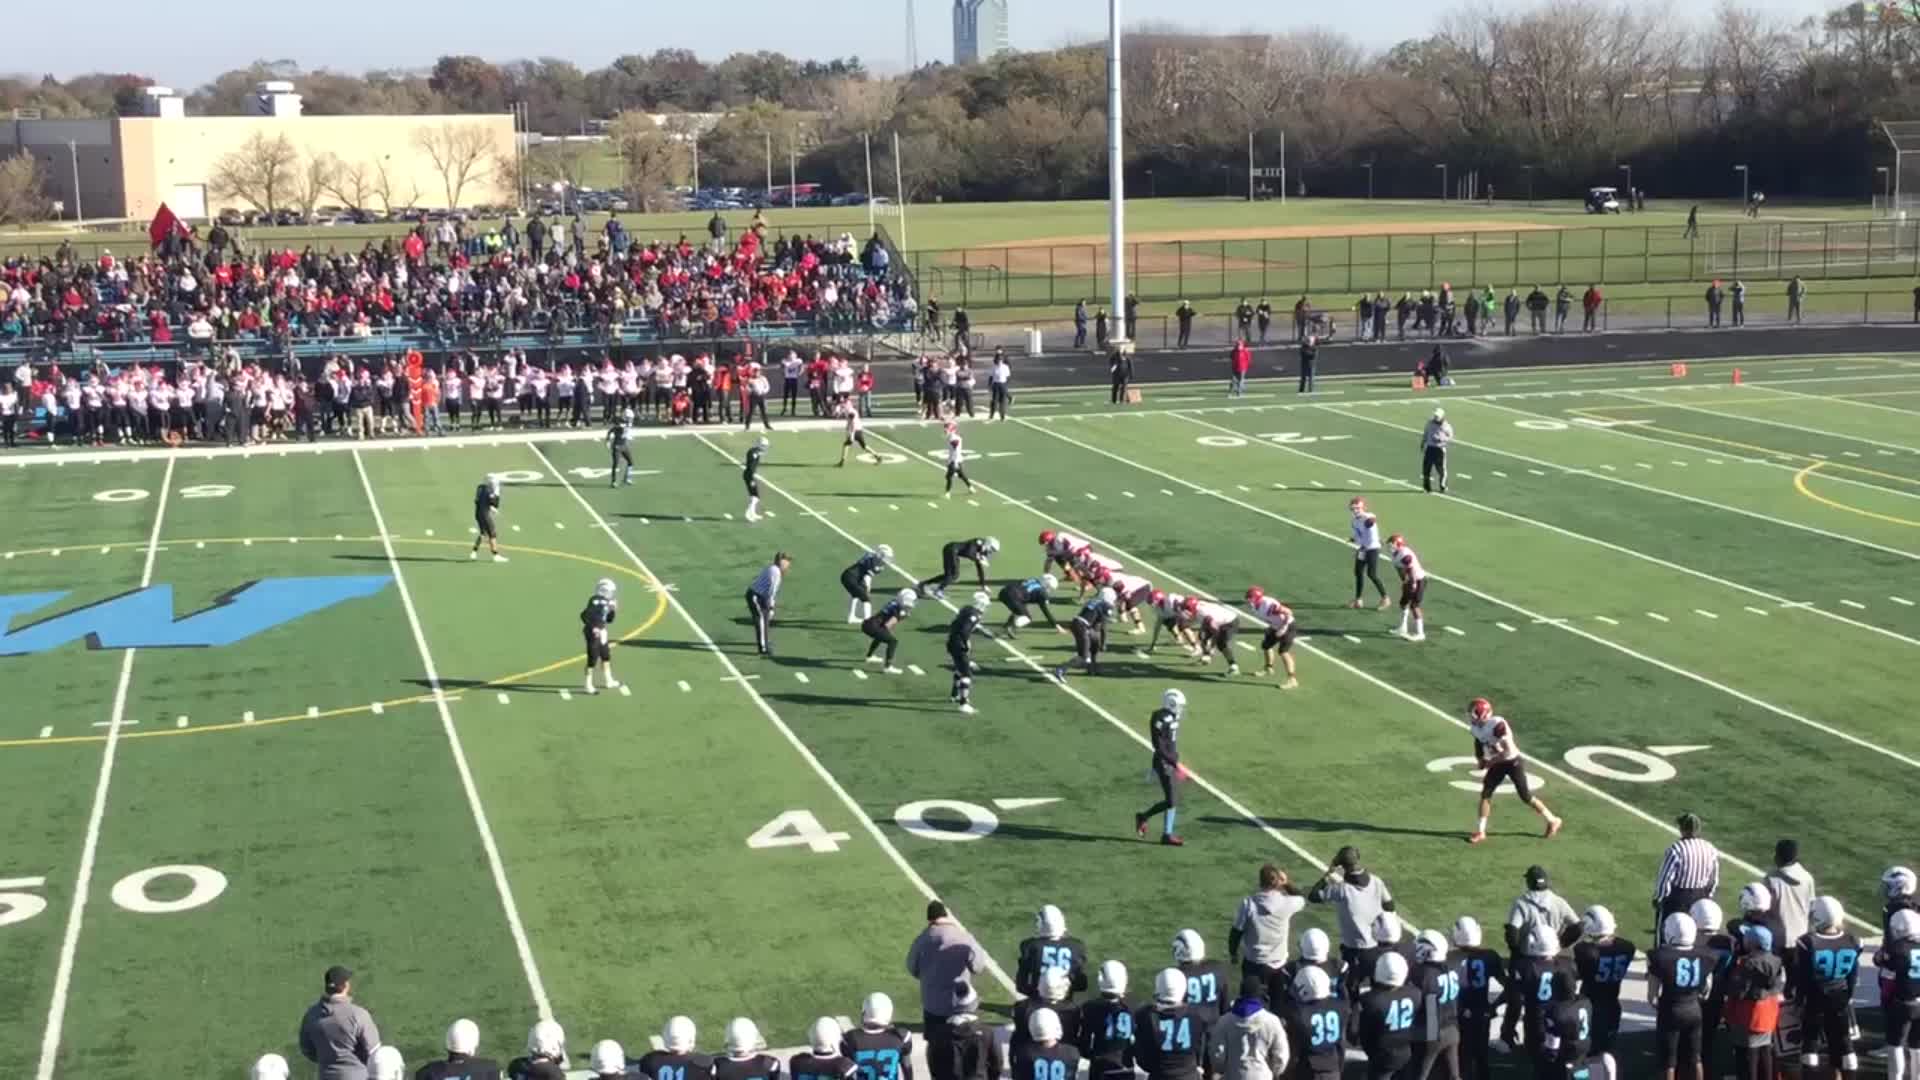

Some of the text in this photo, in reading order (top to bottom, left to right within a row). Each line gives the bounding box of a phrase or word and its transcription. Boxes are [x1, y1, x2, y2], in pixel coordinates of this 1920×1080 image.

[1187, 973, 1217, 1003] 97
[1436, 970, 1460, 1003] 76
[1676, 957, 1701, 987] 61
[1310, 1010, 1340, 1045] 39
[1385, 997, 1414, 1031] 42
[1159, 1017, 1191, 1050] 74
